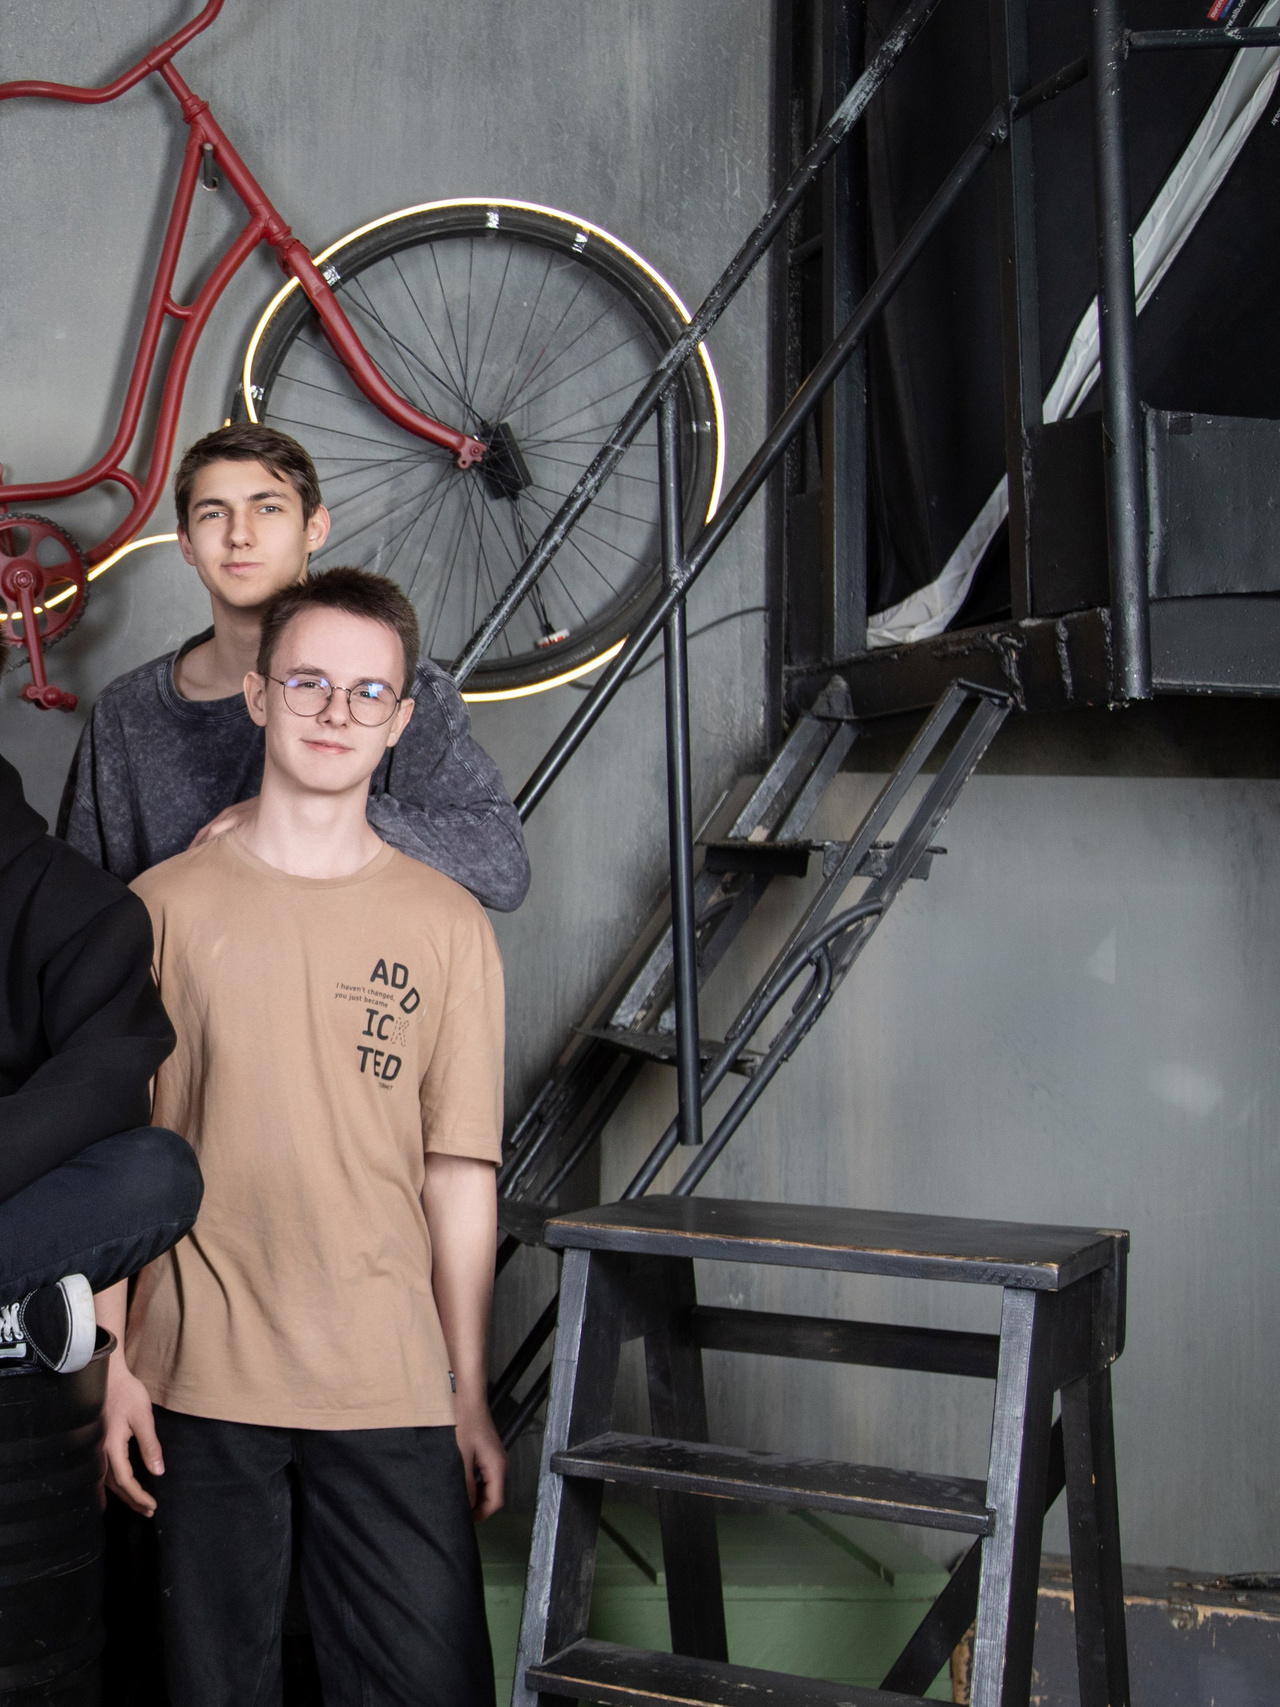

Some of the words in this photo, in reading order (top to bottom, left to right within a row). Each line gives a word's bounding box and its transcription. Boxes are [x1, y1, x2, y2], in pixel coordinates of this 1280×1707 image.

[335, 992, 347, 1000] you
[348, 994, 362, 1002] just
[364, 996, 388, 1008] became
[340, 983, 366, 993] haven't
[367, 988, 396, 1002] changed,
[357, 1045, 402, 1081] TED
